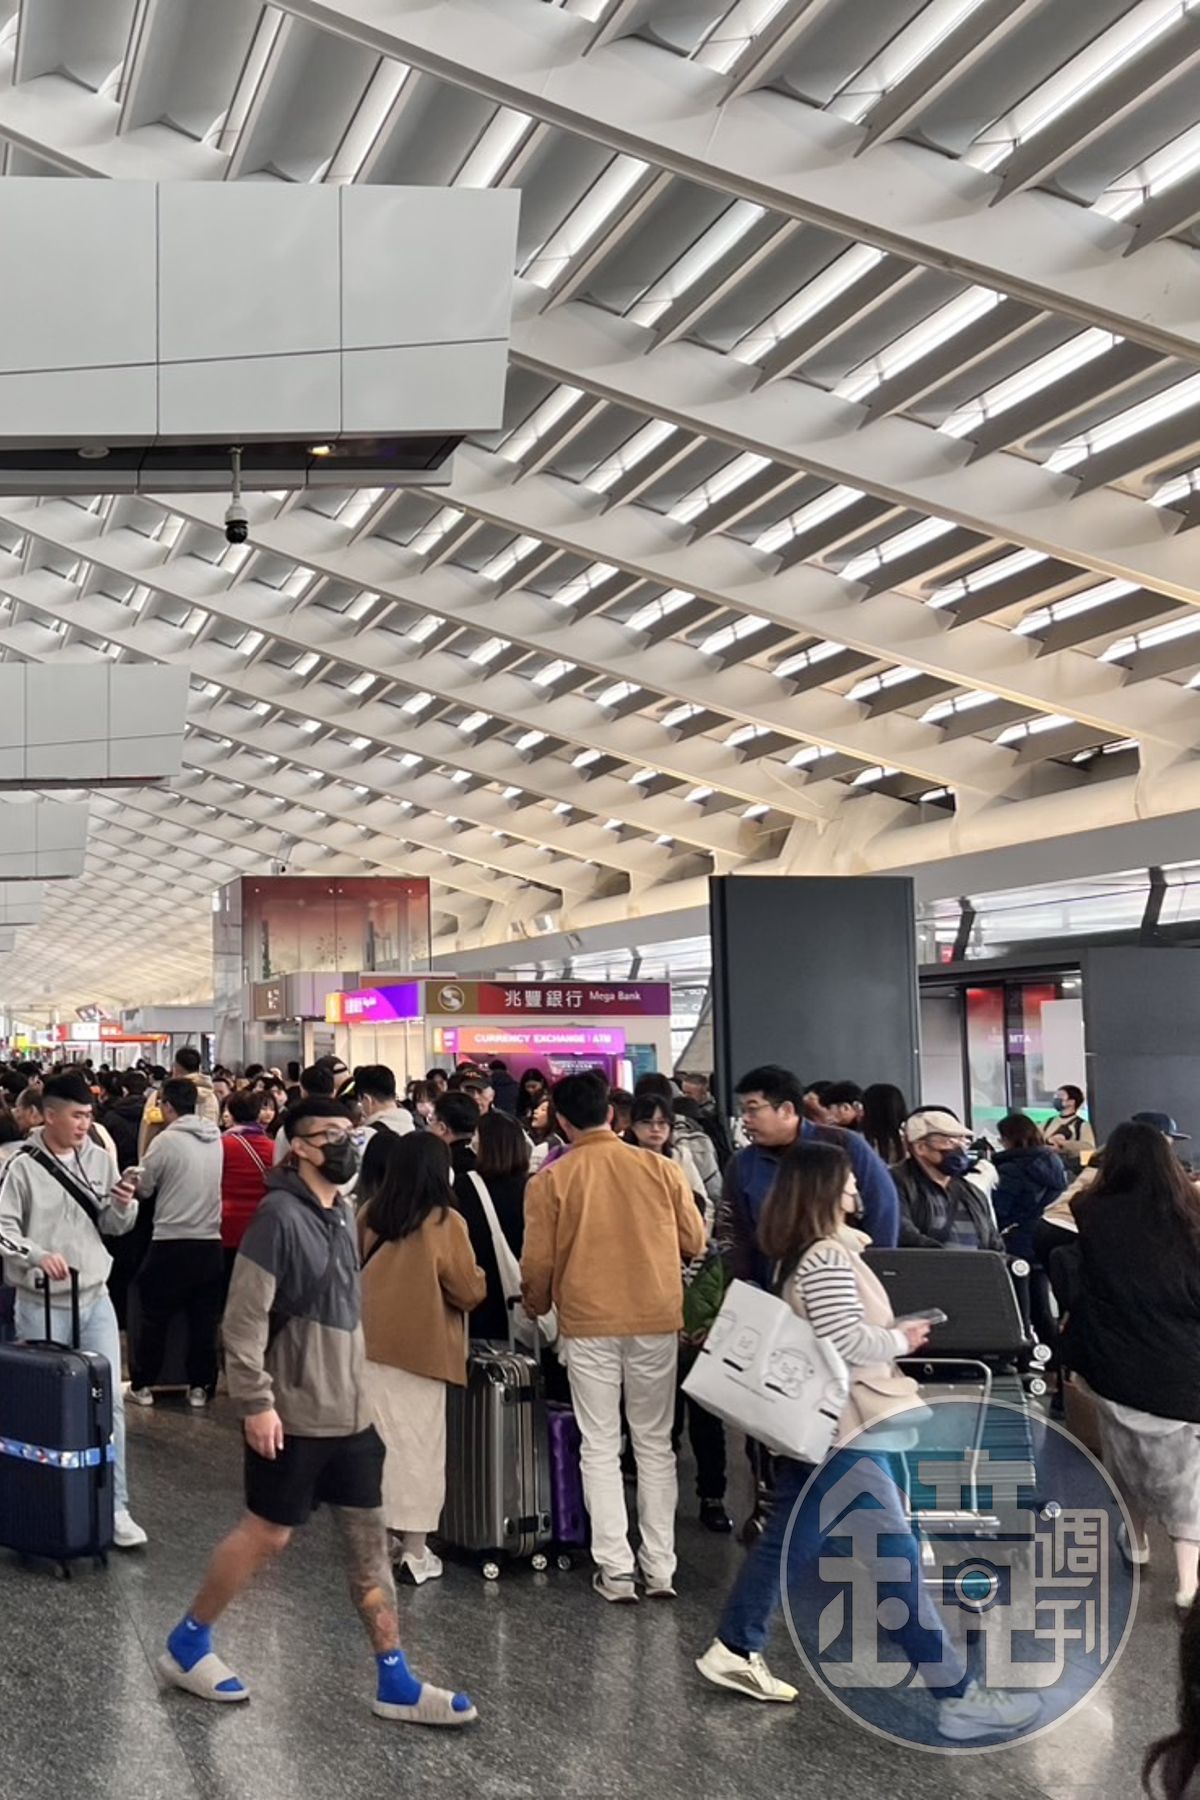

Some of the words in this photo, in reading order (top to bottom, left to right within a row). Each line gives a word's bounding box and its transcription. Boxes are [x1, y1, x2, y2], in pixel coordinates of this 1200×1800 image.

[504, 990, 583, 1007] 兆豐銀行
[589, 991, 614, 1003] Mega
[618, 991, 641, 1000] Bank
[474, 1034, 530, 1044] CURRENCY
[534, 1034, 585, 1044] EXCHANGE
